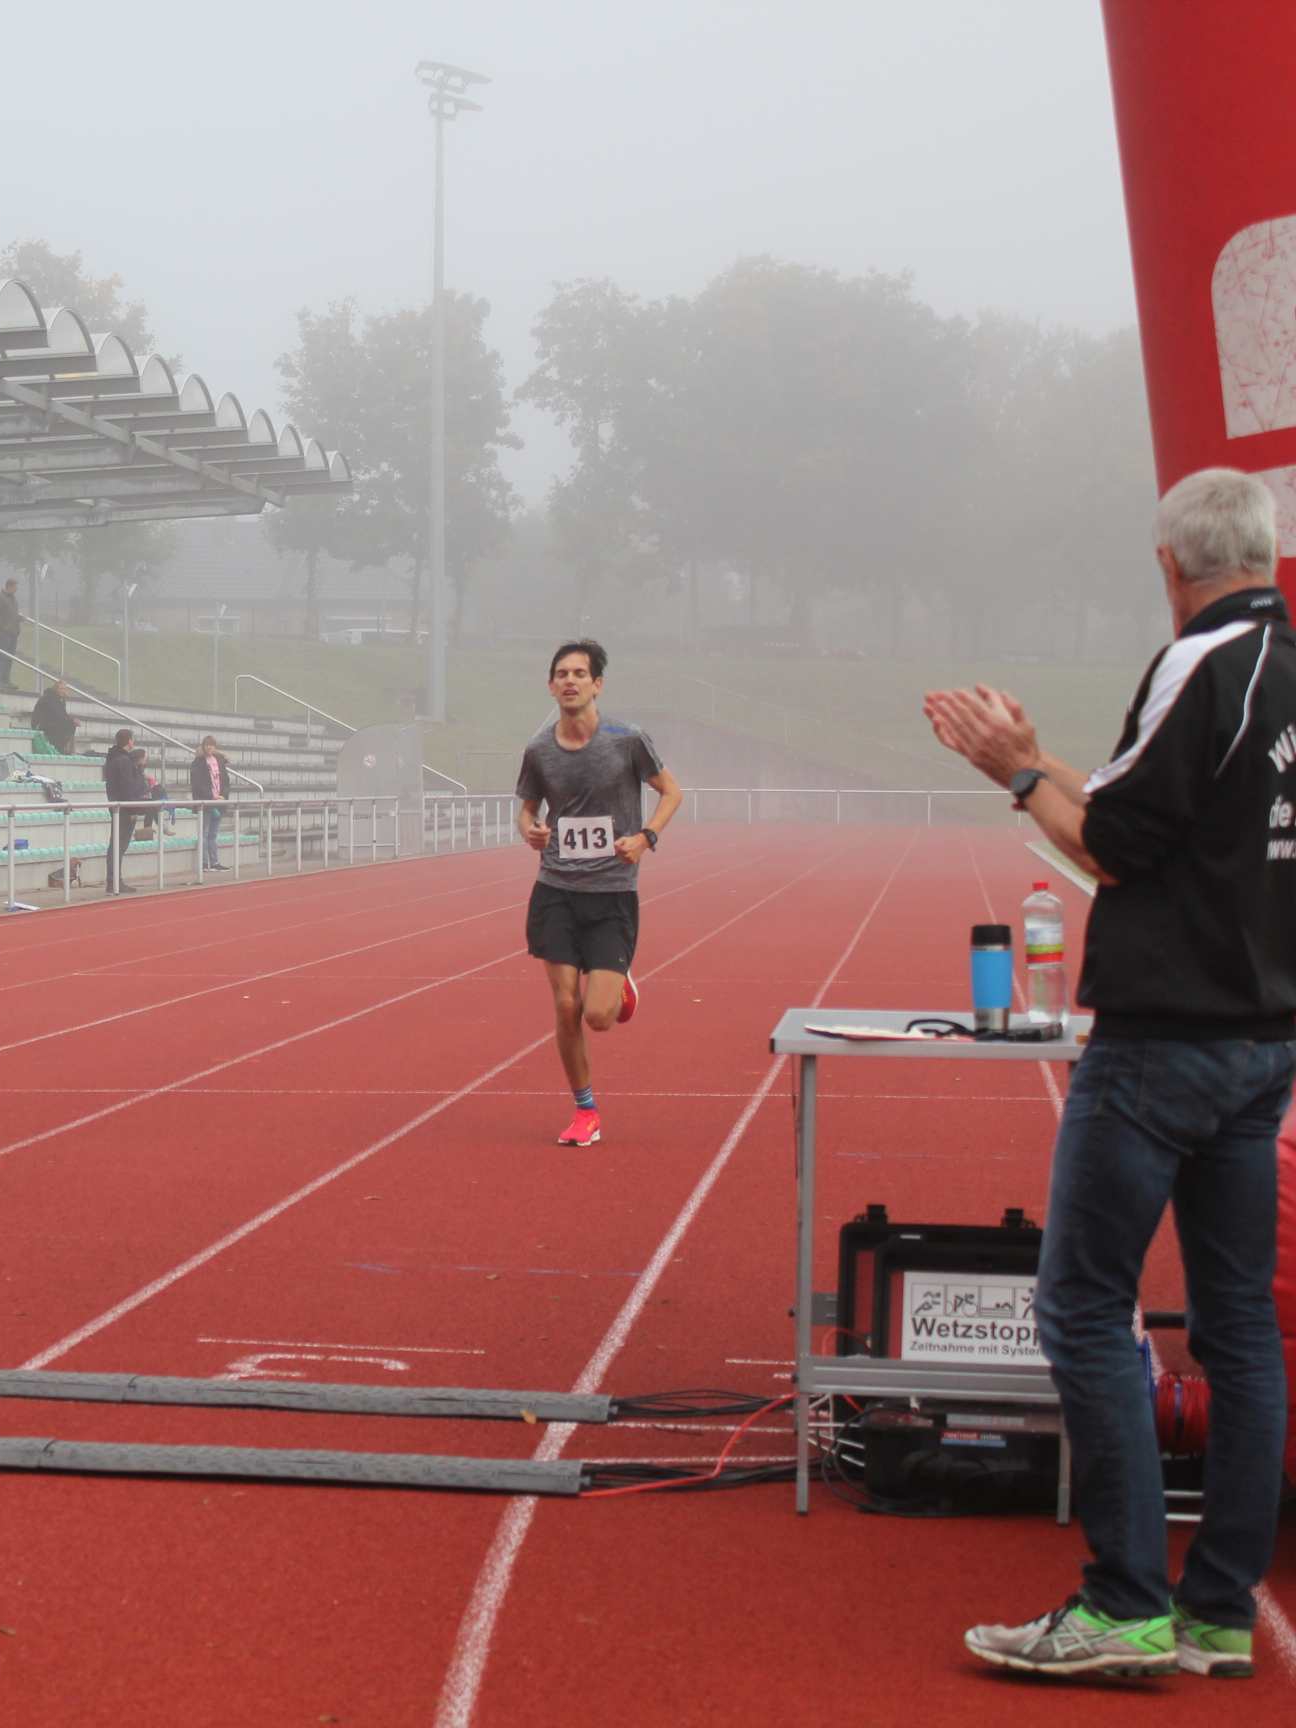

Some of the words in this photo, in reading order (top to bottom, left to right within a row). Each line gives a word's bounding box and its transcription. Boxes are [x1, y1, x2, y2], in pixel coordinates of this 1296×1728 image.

[564, 827, 607, 850] 413
[910, 1341, 975, 1354] Zeitnahme
[978, 1345, 998, 1354] mit
